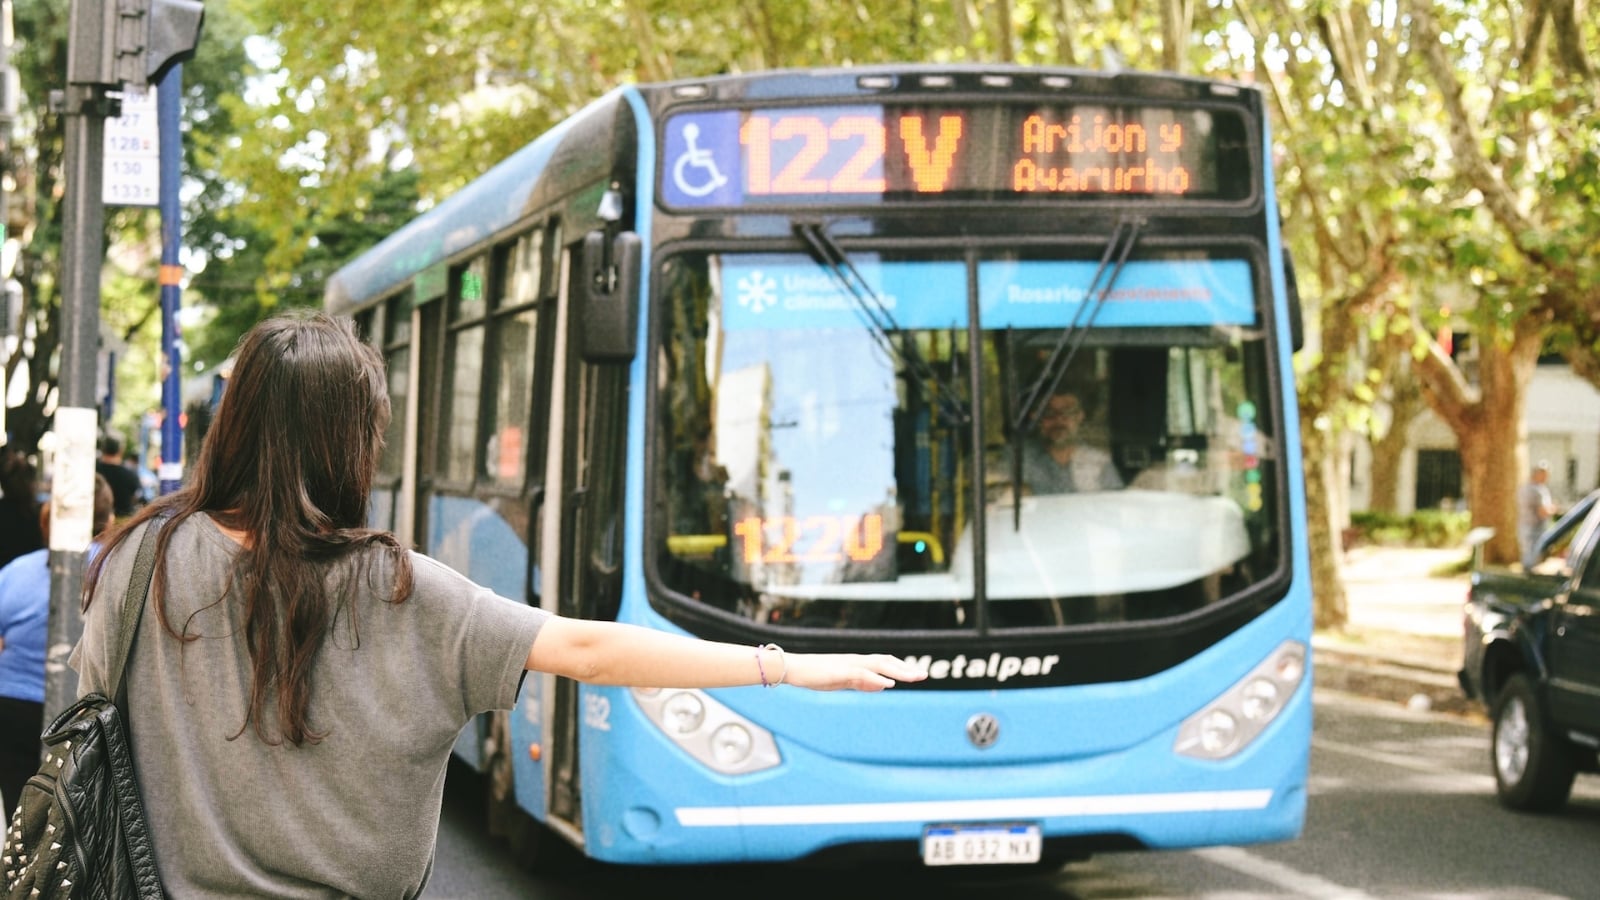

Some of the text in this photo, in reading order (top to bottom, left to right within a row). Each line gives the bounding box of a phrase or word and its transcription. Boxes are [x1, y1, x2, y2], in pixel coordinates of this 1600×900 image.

[740, 115, 962, 193] 122 V
[1023, 114, 1182, 153] Arijon y
